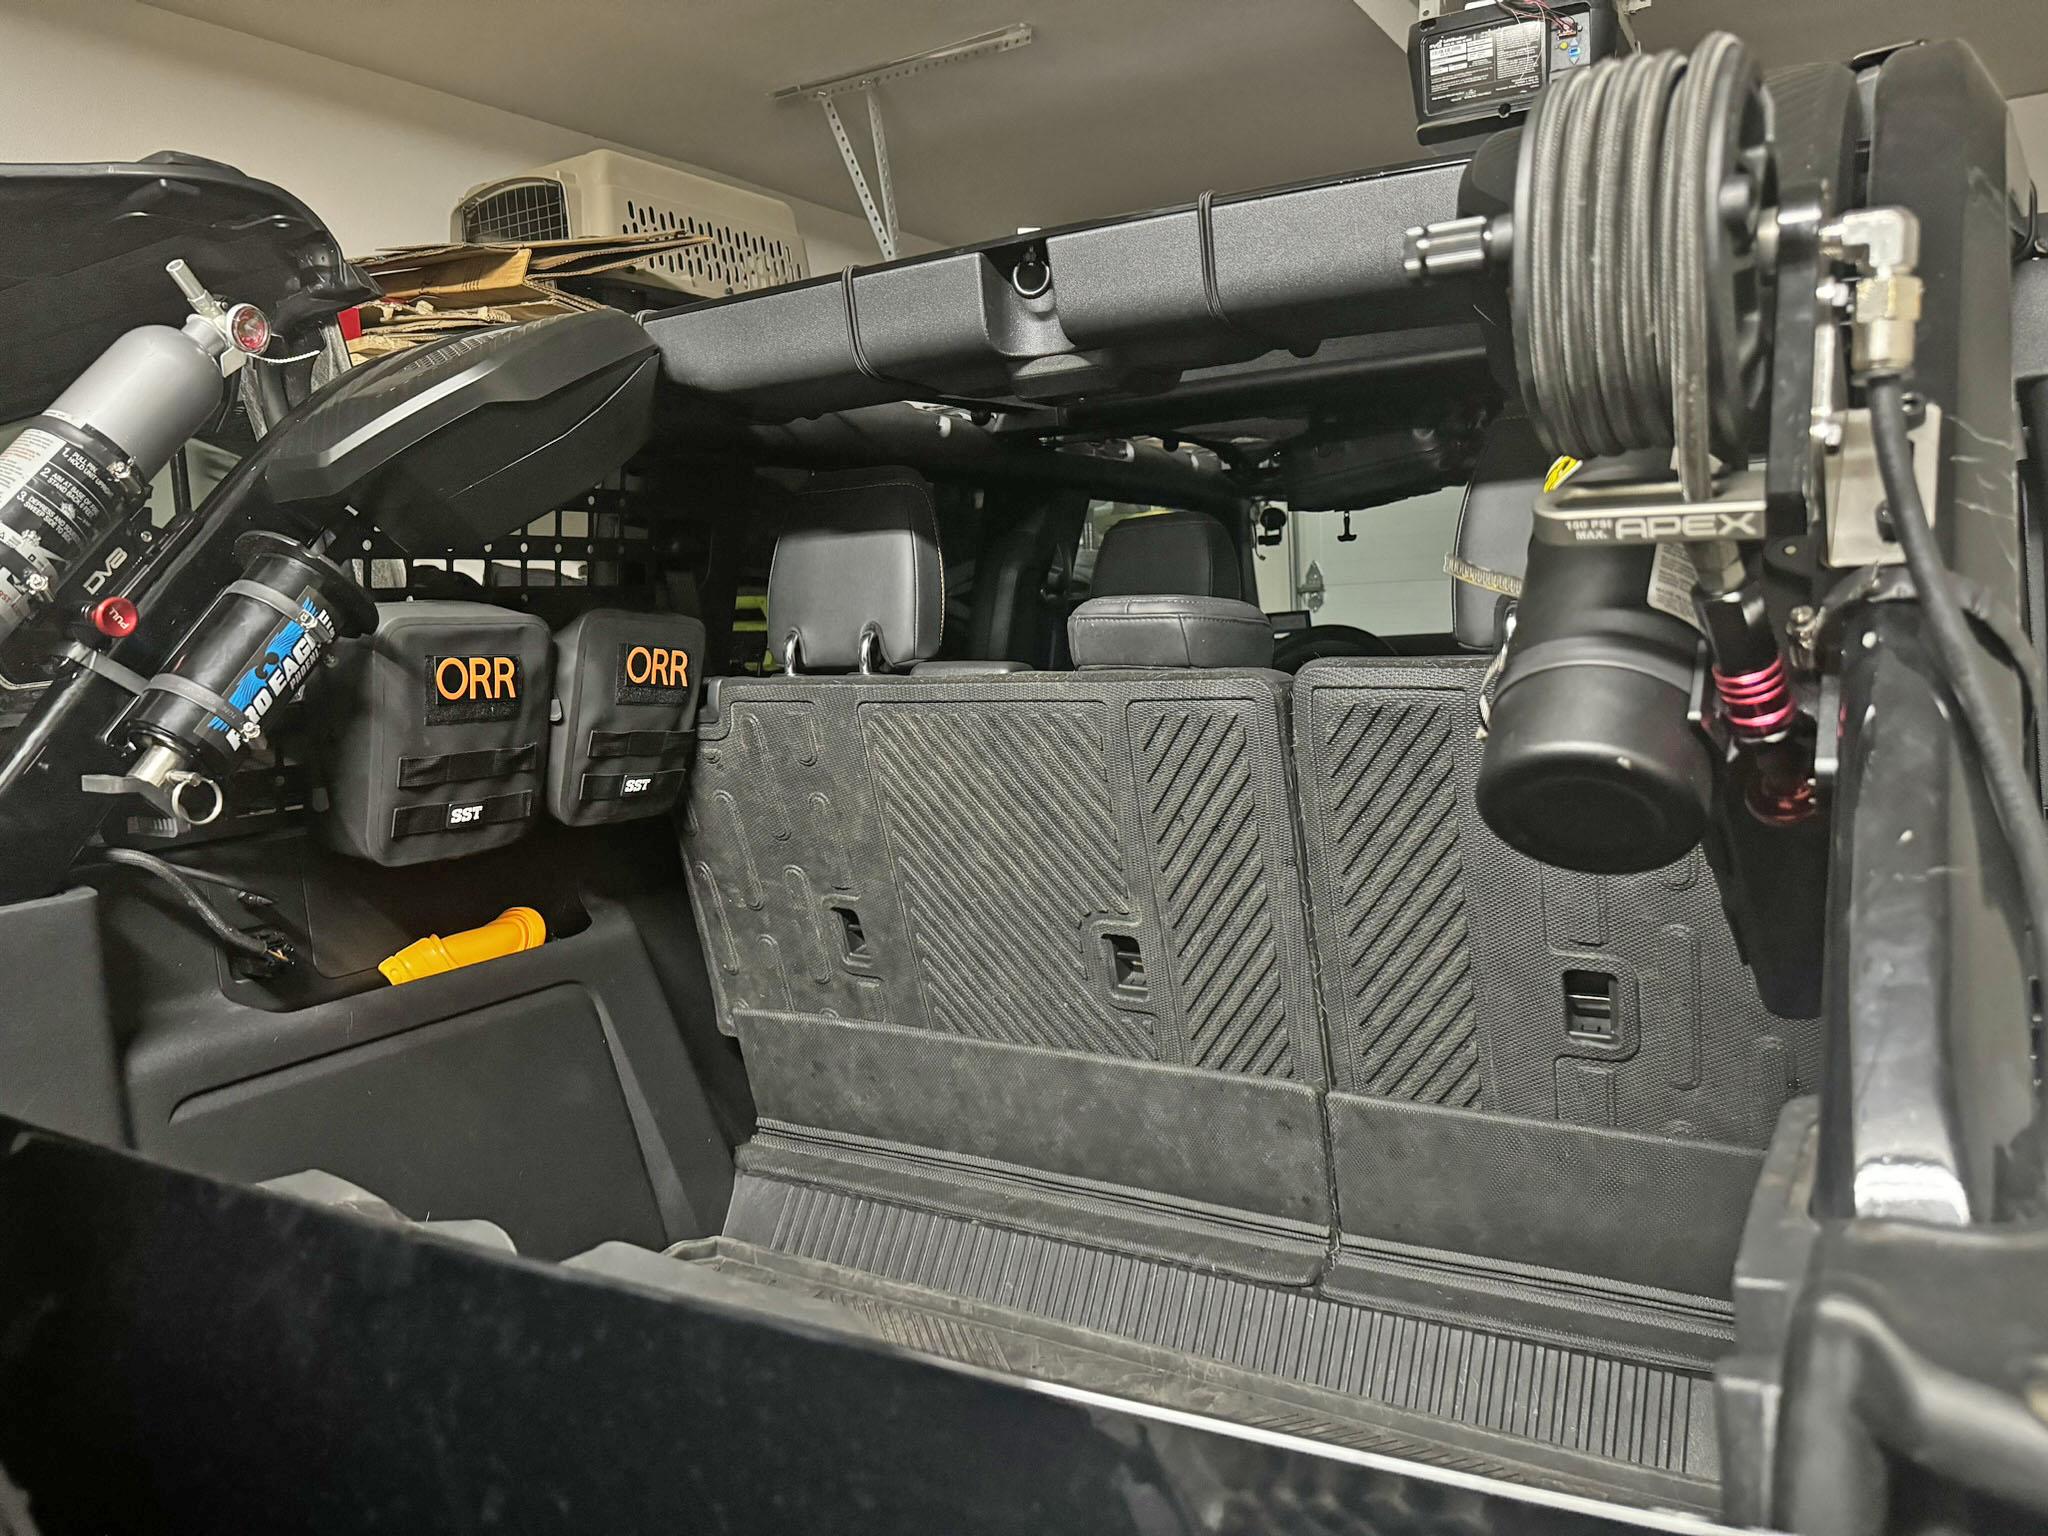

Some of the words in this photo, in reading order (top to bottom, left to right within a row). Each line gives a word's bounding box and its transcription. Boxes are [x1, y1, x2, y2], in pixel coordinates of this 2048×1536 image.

[68, 456, 85, 471] HOLD
[83, 468, 97, 480] UNIT
[71, 451, 88, 465] PULL
[47, 477, 67, 494] STAND
[65, 490, 82, 506] BACK
[52, 472, 64, 484] AIM
[63, 480, 72, 489] AT
[70, 484, 86, 500] BASE
[23, 502, 46, 520] SWEEP
[43, 515, 58, 528] SIDE
[55, 524, 64, 534] TO
[28, 495, 56, 517] DEPRESS
[53, 513, 66, 527] AND
[1590, 518, 1613, 529] PSI
[1615, 512, 1757, 540] APEX
[109, 606, 130, 630] PULL
[436, 657, 516, 700] ORR
[626, 646, 688, 688] ORR
[225, 687, 273, 752] PRO
[624, 778, 651, 793] SST
[450, 805, 483, 825] SST
